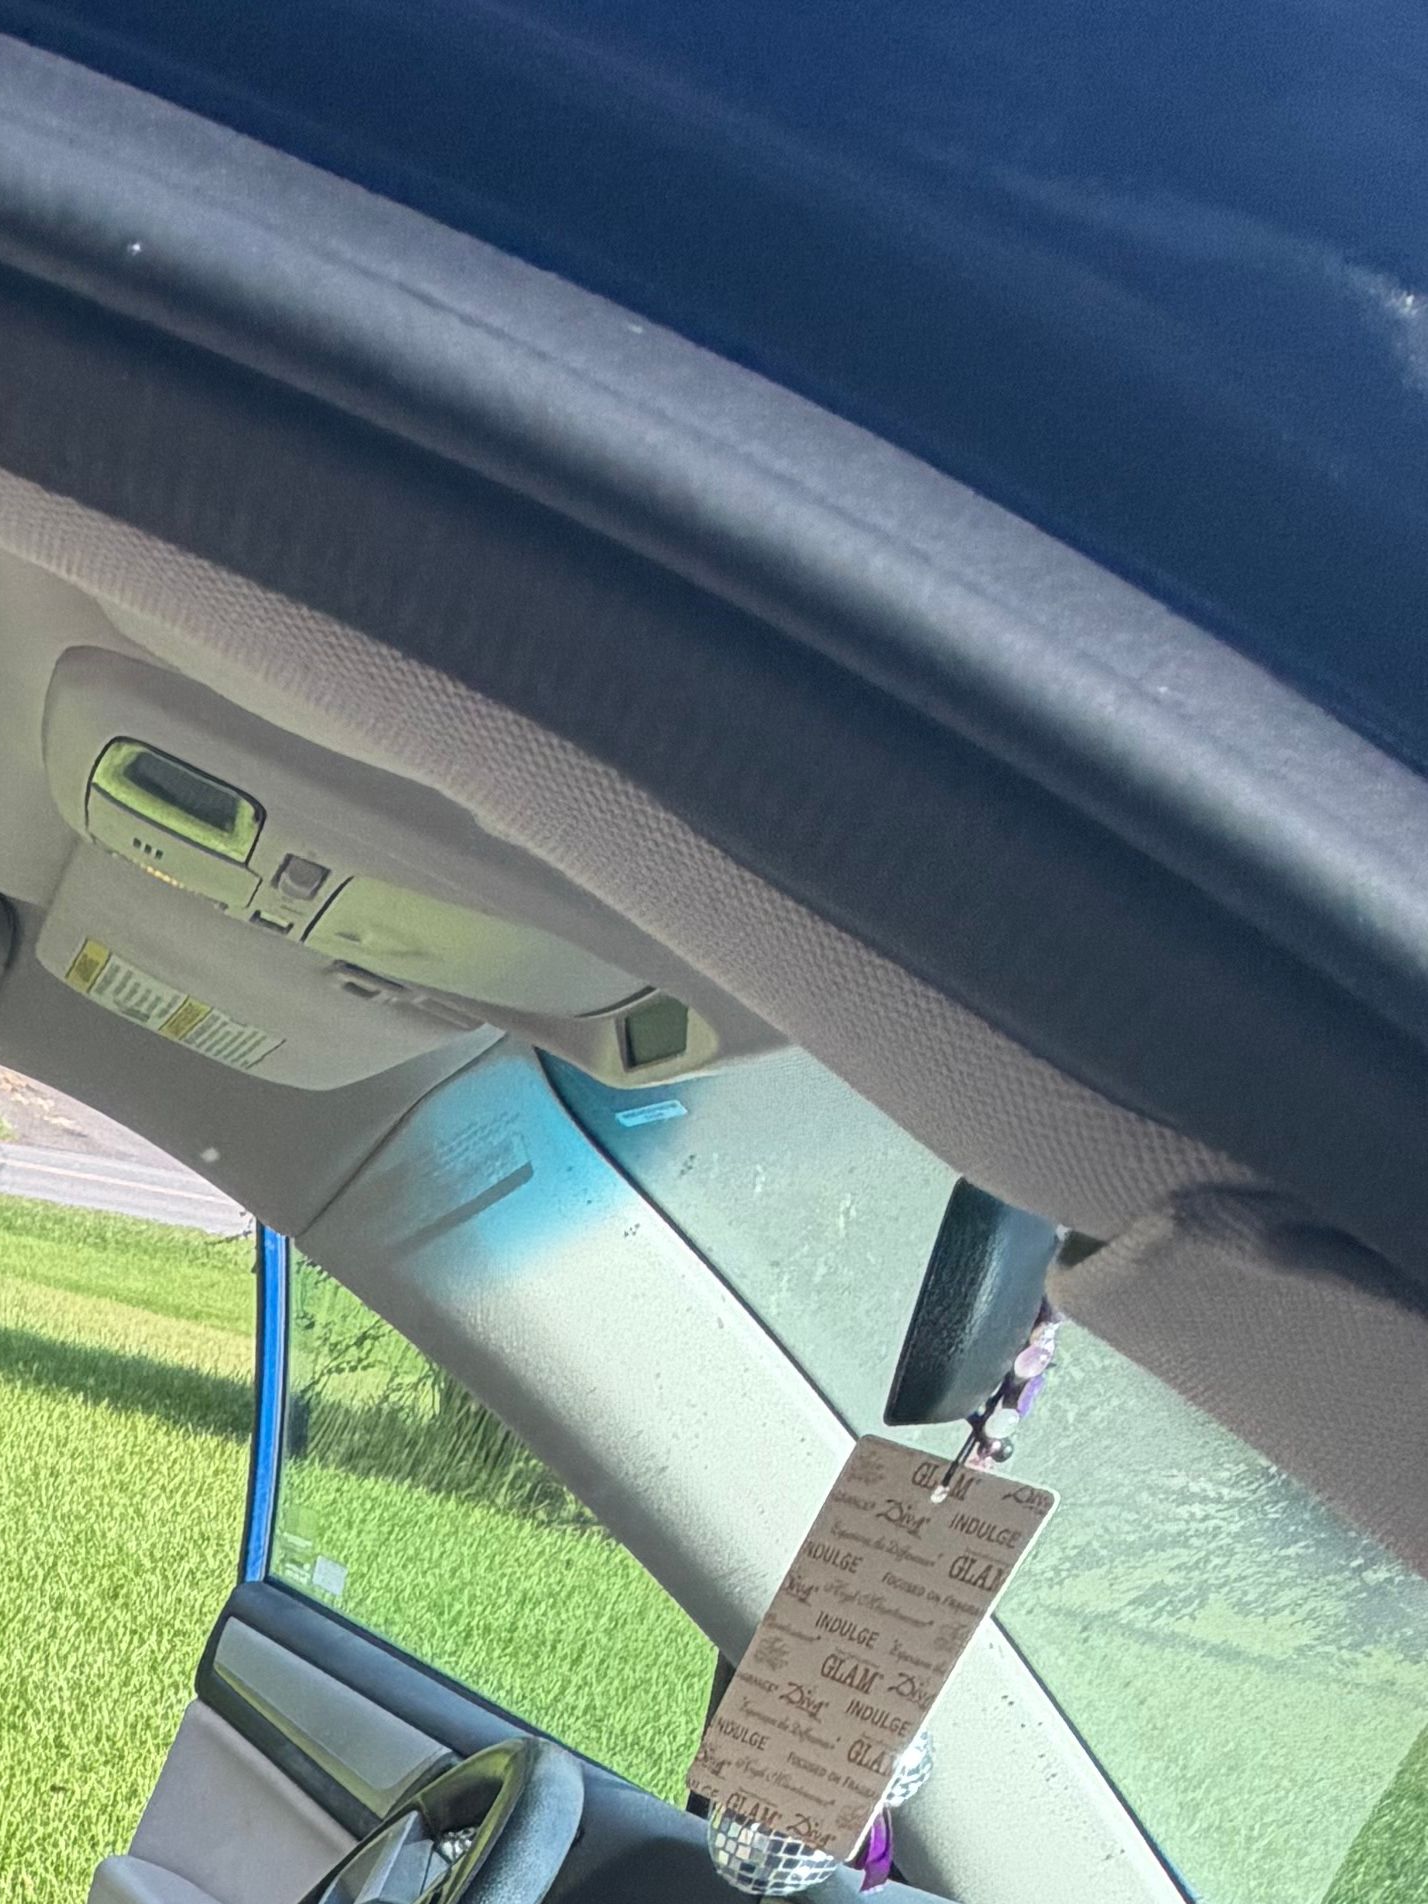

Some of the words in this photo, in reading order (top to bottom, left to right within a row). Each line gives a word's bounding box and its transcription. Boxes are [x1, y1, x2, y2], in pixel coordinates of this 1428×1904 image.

[876, 1499, 925, 1535] Diva
[951, 1515, 1021, 1548] INDULGE
[817, 1613, 880, 1648] INDULGE
[780, 1682, 825, 1719] Diva
[847, 1701, 910, 1737] INDULGE
